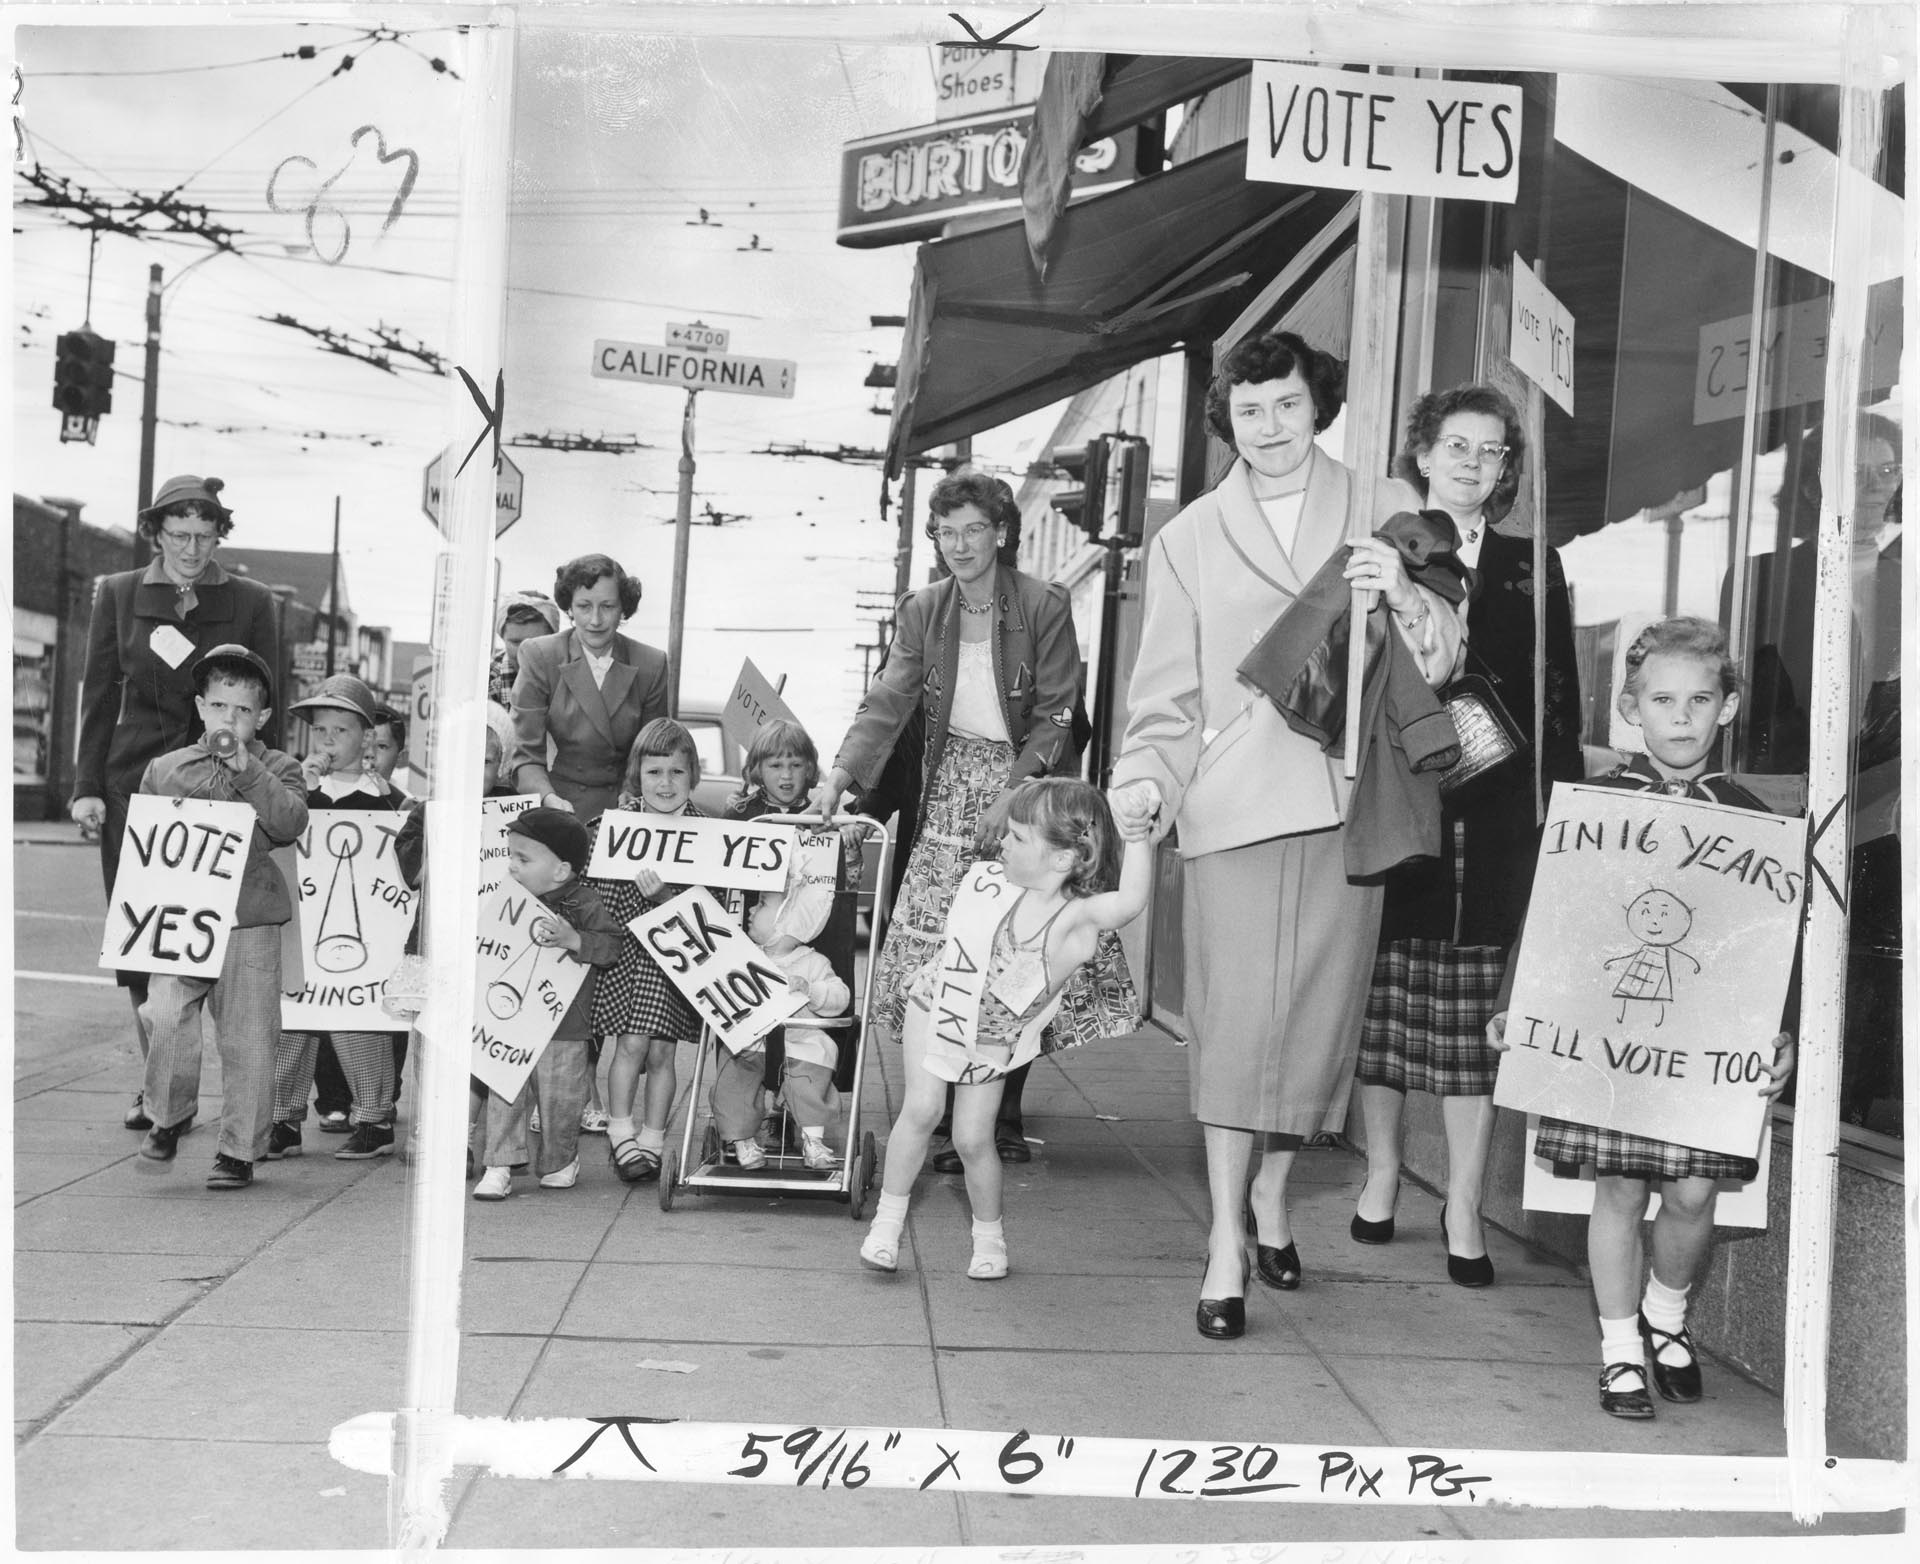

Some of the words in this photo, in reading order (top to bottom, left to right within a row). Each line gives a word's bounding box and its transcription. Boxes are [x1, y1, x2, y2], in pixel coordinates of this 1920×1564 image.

[940, 72, 1003, 100] Shoes
[1267, 82, 1395, 171] VOTE
[1427, 100, 1513, 179] YES
[601, 347, 765, 388] CALIFORNIA
[684, 330, 724, 346] 4700
[1518, 300, 1540, 341] VOTE
[1549, 317, 1570, 388] YES
[737, 684, 766, 726] VOTE
[500, 800, 533, 814] WENT
[128, 821, 243, 879] VOTE
[608, 825, 698, 864] VOTE
[723, 834, 787, 871] YES
[798, 834, 834, 848] WENT
[1546, 820, 1603, 855] IN
[1620, 818, 1659, 854] 16
[1677, 824, 1802, 905] YEARS
[371, 877, 411, 914] FOR
[120, 901, 221, 964] YES
[648, 902, 732, 974] YES
[476, 936, 511, 961] HIS
[538, 979, 564, 1021] FOR
[696, 961, 788, 1033] VOTE
[936, 937, 978, 1048] ALKI
[1519, 1016, 1584, 1062] I'LL
[1602, 1037, 1689, 1079] VOTE
[1704, 1050, 1763, 1085] TOO
